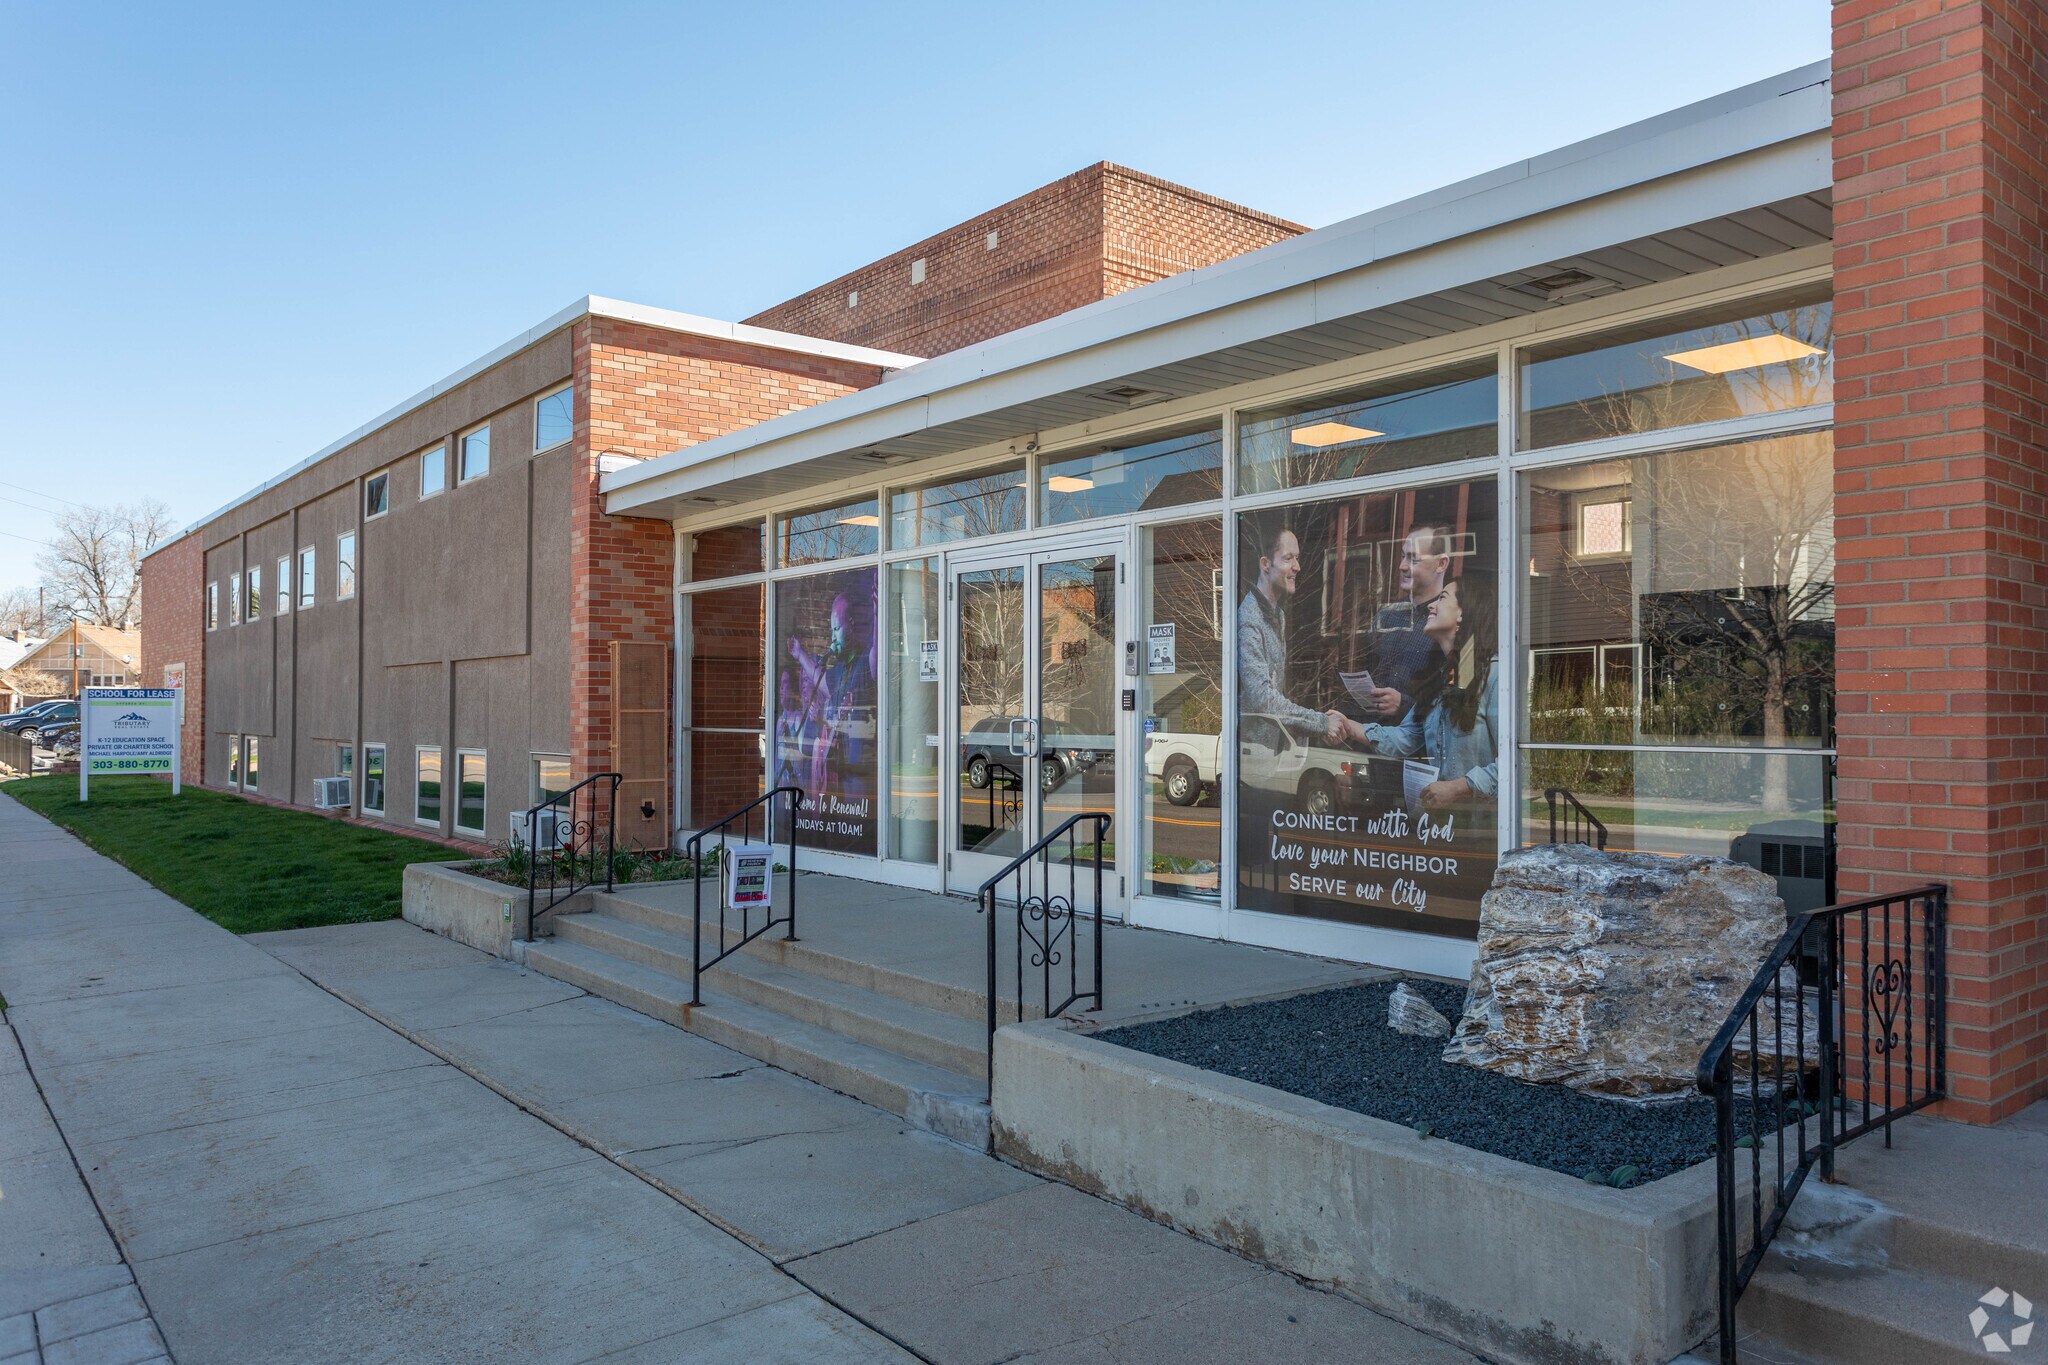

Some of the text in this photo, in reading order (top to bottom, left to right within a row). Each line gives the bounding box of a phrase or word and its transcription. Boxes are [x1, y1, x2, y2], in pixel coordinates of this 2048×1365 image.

[1151, 627, 1172, 637] MASK
[89, 690, 175, 698] SCHOOL FOR LEASE
[93, 760, 169, 769] 303-880-8770
[819, 793, 827, 814] To
[830, 795, 869, 818] Renewal!
[795, 818, 863, 836] UNDAYS AT 10AM!
[1272, 808, 1455, 846] CONNECT with God
[1309, 846, 1349, 870] your
[1353, 848, 1458, 876] NEIGHBOR
[1289, 872, 1427, 913] SERVE our City
